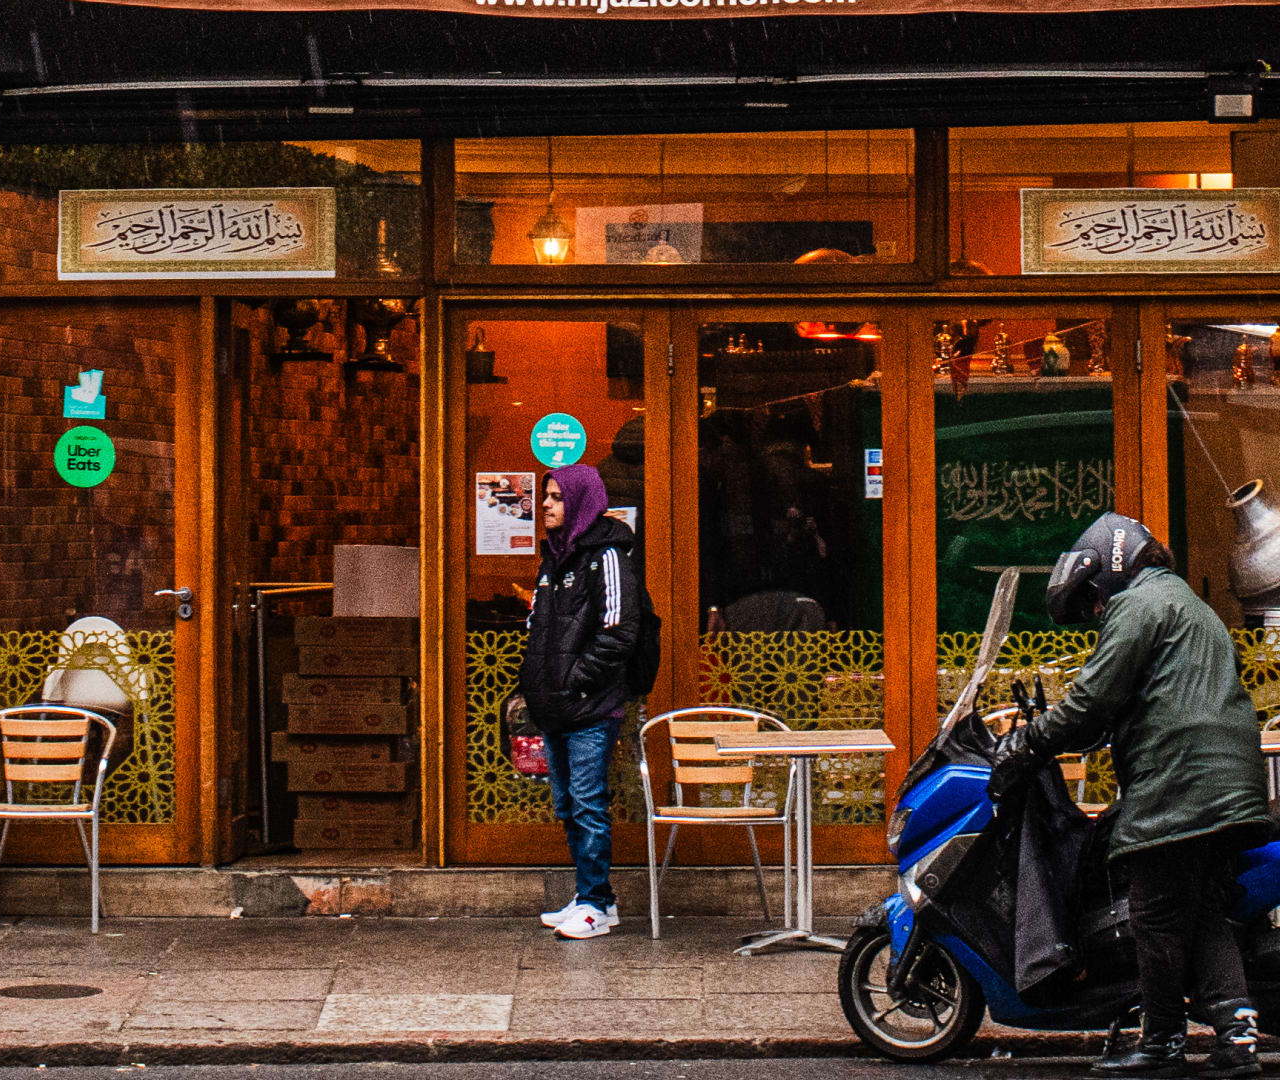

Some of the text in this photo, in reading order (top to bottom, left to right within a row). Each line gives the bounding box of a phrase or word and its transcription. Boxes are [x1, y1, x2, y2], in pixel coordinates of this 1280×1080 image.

[67, 444, 101, 458] Uber
[67, 458, 101, 471] Eats
[1111, 528, 1126, 572] LEOPARD
